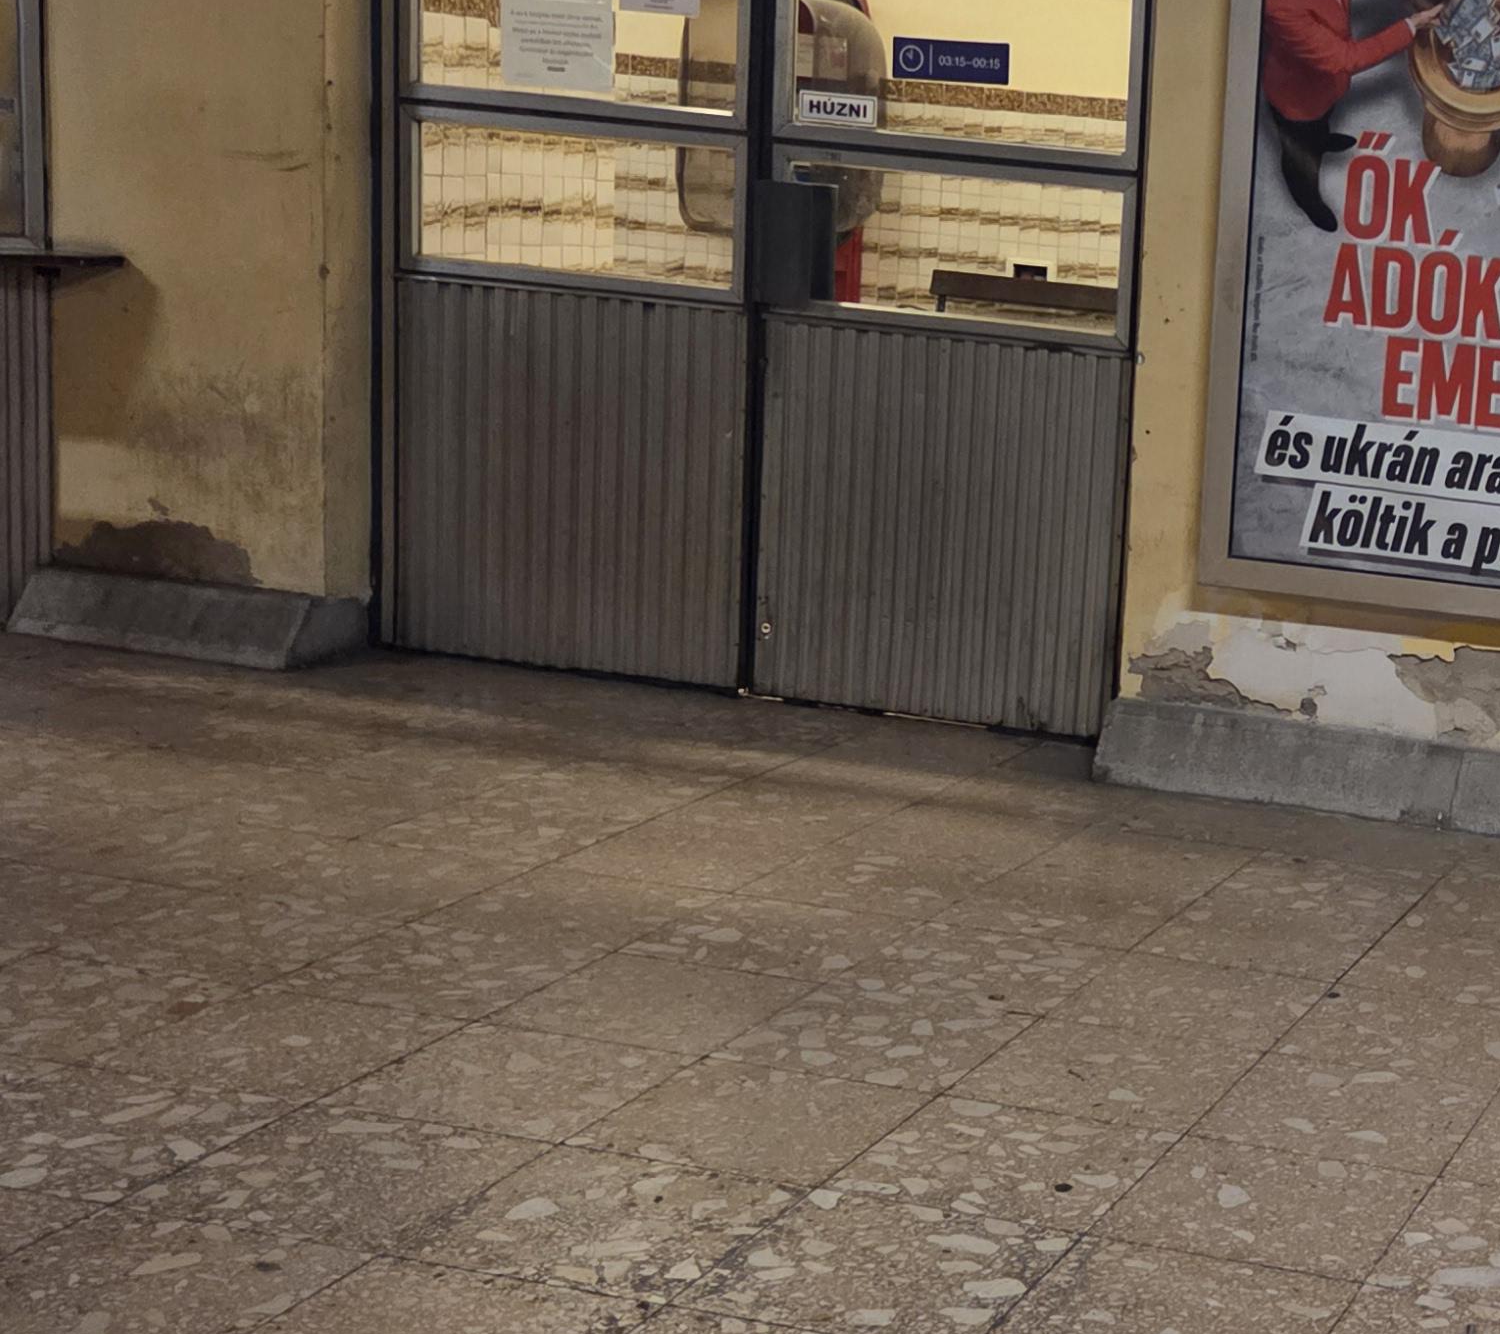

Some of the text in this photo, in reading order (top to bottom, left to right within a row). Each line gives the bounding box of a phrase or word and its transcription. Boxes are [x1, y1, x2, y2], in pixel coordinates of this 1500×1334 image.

[809, 98, 867, 118] HÚZNI
[1264, 414, 1314, 469] és
[1320, 424, 1441, 485] ukrán
[1308, 491, 1437, 556] költik
[1441, 520, 1469, 560] a
